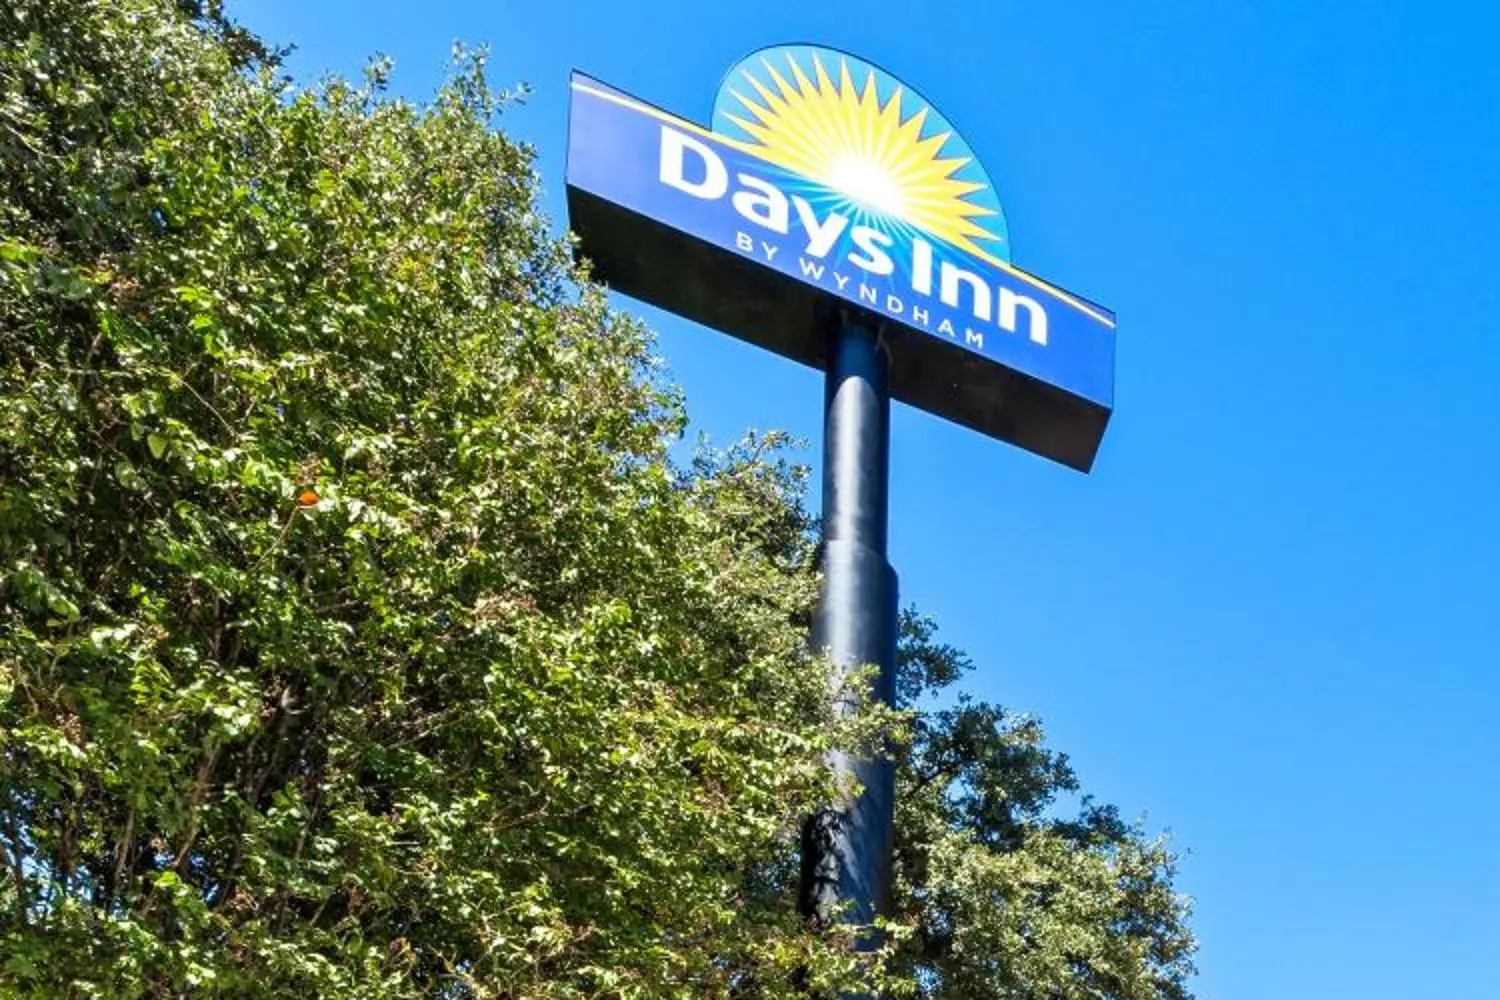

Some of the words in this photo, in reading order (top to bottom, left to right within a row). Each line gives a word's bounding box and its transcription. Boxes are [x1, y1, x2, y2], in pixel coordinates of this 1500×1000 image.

[659, 125, 895, 276] Days
[911, 236, 1049, 346] Inn
[736, 231, 779, 261] BY
[799, 257, 985, 349] WYNDHAM
